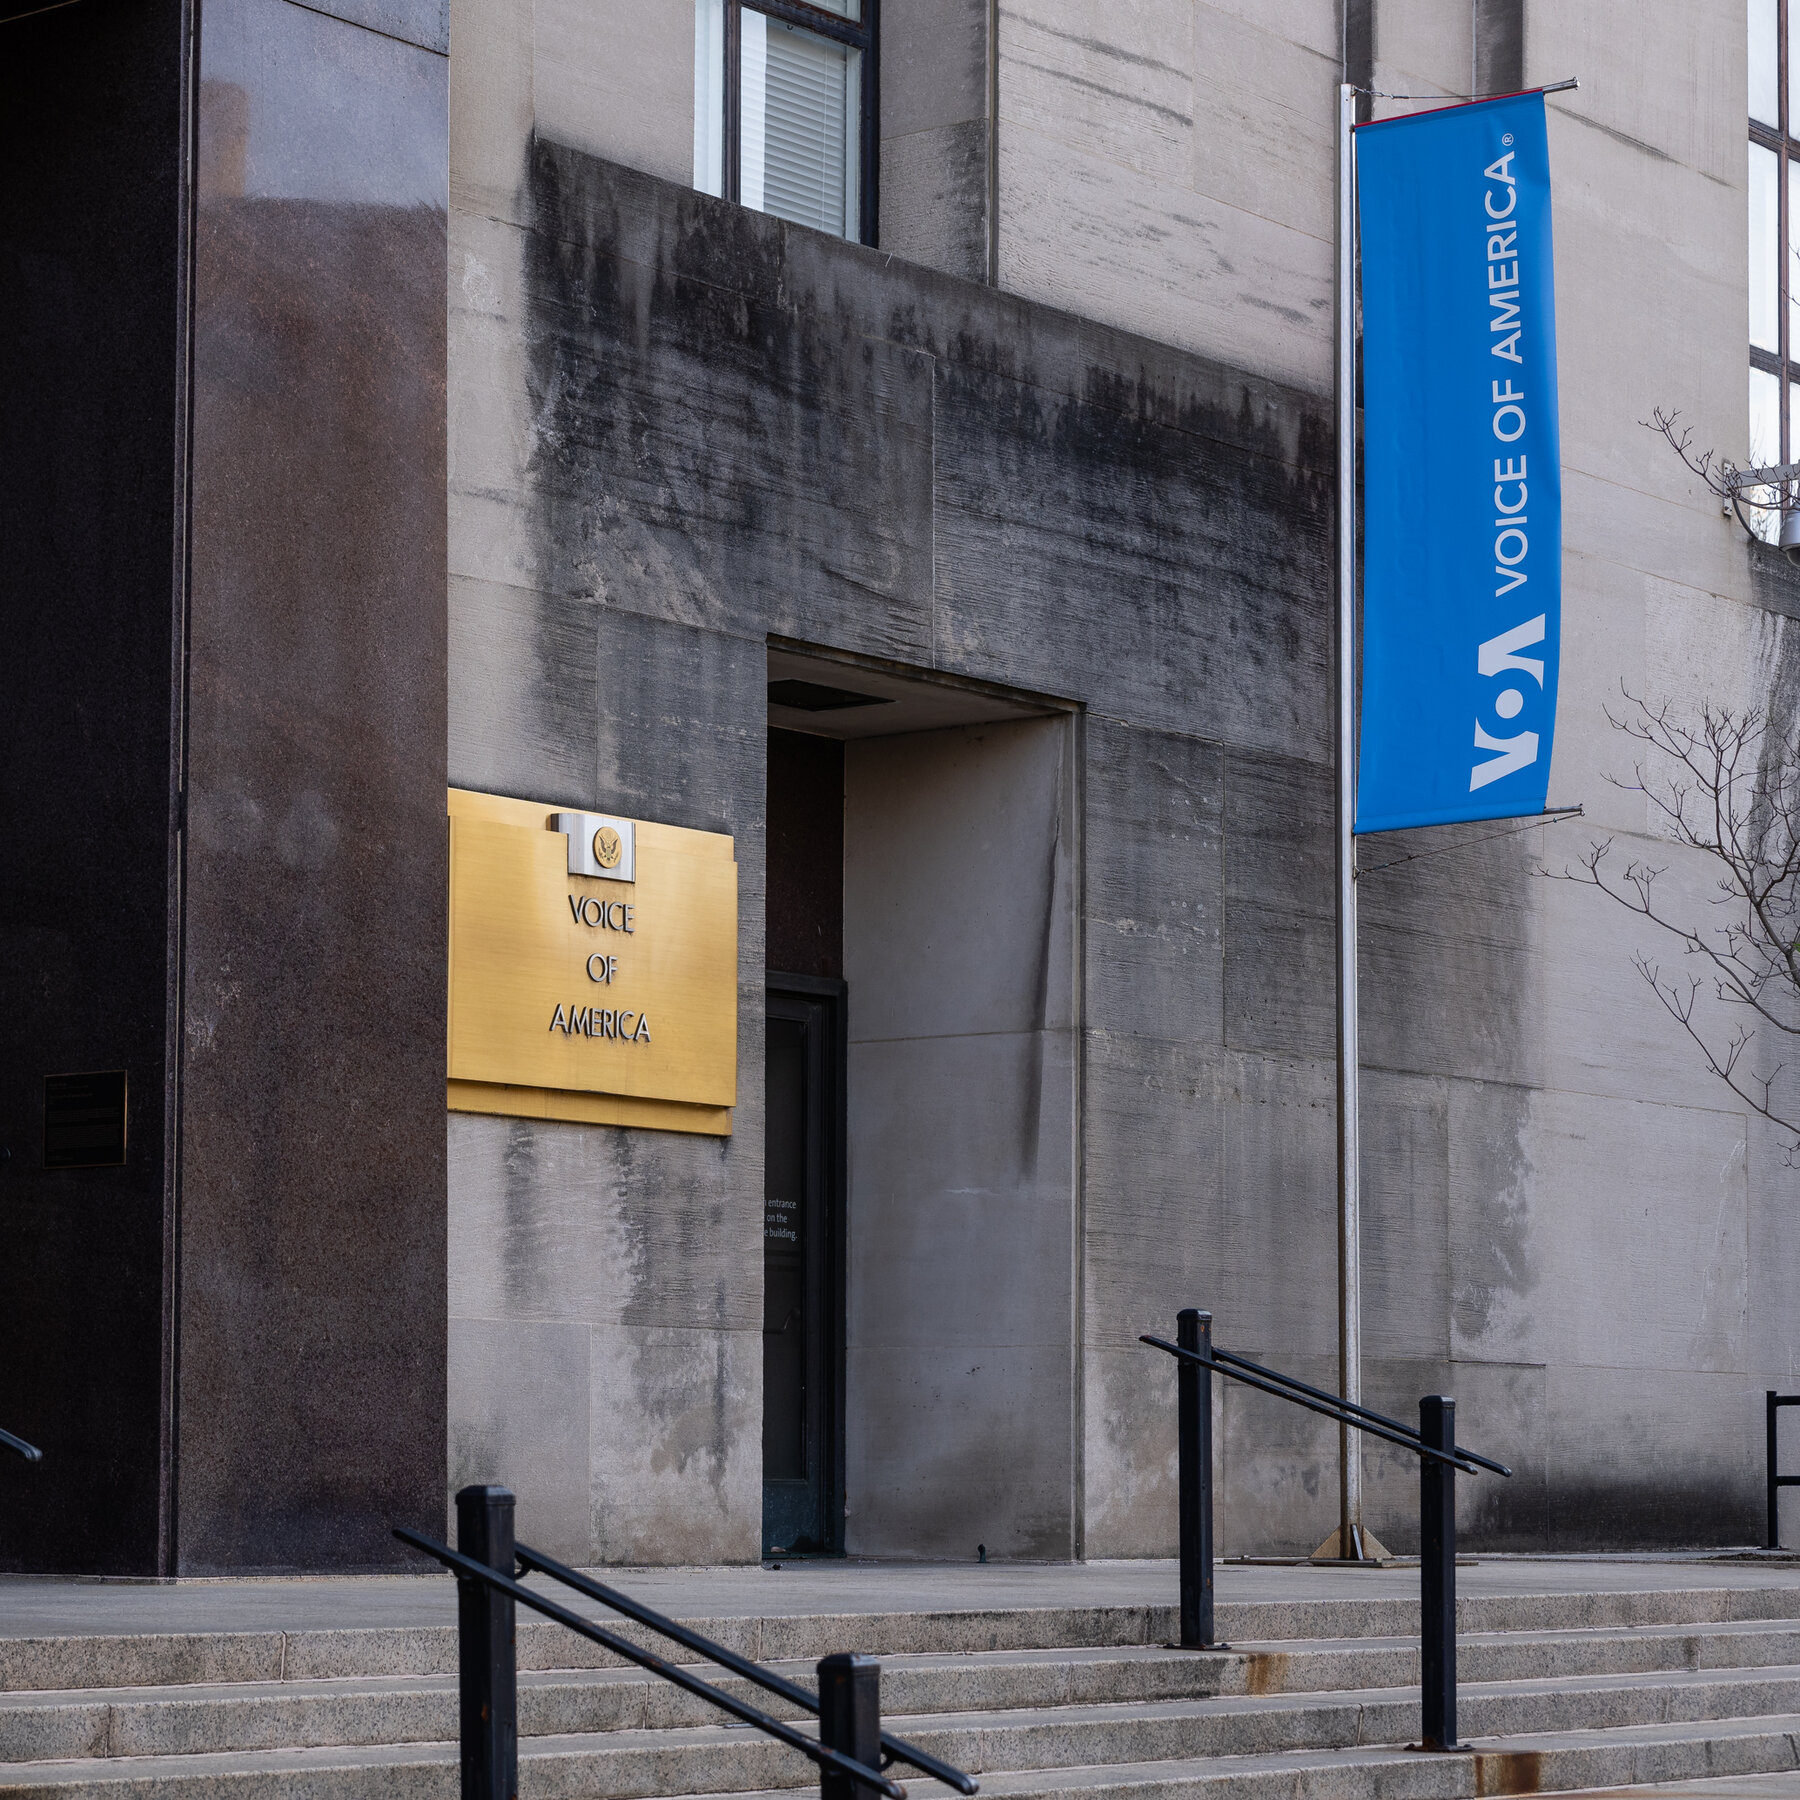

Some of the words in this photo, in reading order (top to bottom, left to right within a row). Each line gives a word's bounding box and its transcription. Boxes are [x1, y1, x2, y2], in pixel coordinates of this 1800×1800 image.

[1492, 379, 1527, 442] OF
[1492, 454, 1528, 598] VOICE
[568, 894, 635, 933] VOICE
[586, 953, 618, 984] OF
[549, 1003, 651, 1042] AMERICA
[766, 1214, 776, 1222] on
[776, 1212, 788, 1223] the
[768, 1199, 797, 1209] entrance
[769, 1227, 798, 1242] building.
